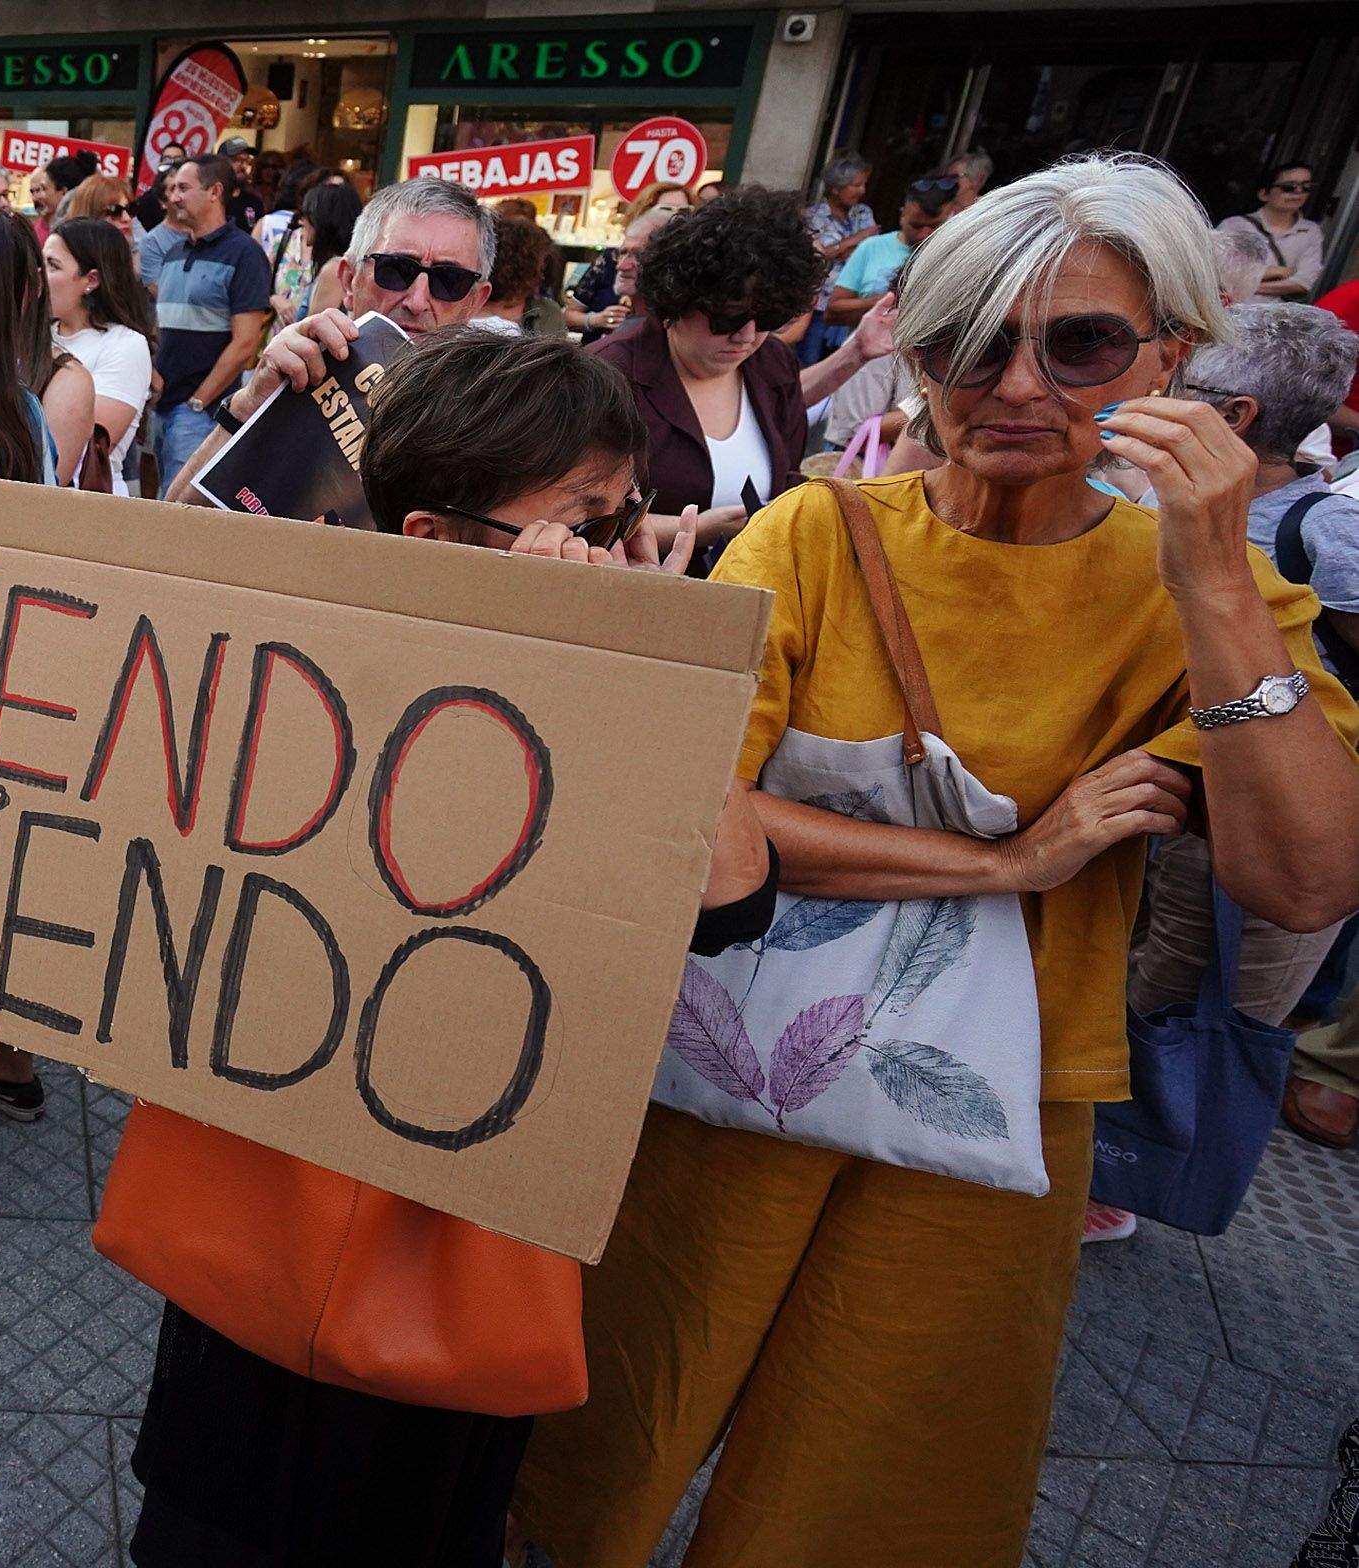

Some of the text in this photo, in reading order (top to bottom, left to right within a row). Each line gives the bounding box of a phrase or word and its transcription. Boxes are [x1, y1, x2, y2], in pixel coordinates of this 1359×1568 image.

[441, 38, 704, 80] ARESSO
[8, 138, 120, 177] REBAS
[625, 138, 698, 190] 70
[235, 487, 262, 512] POR
